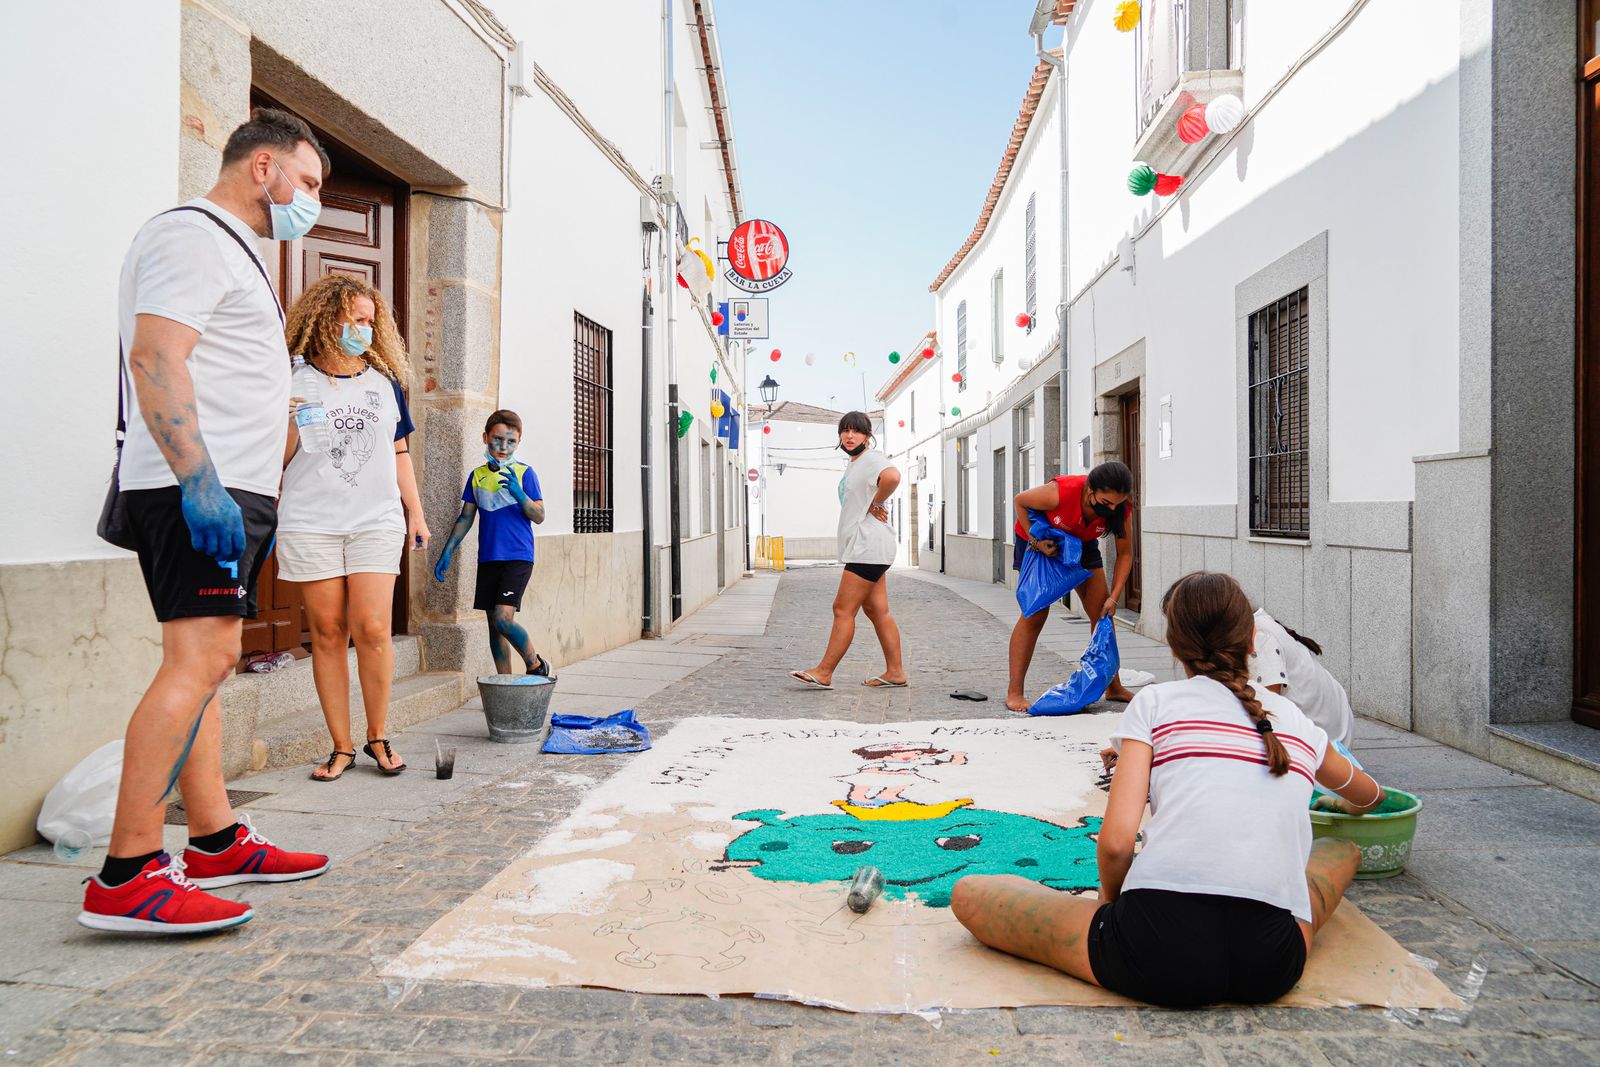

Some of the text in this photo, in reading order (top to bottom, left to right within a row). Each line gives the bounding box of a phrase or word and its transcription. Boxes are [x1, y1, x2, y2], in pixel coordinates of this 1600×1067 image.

[729, 271, 789, 290] BAR LA CUEVA
[346, 404, 380, 423] juego
